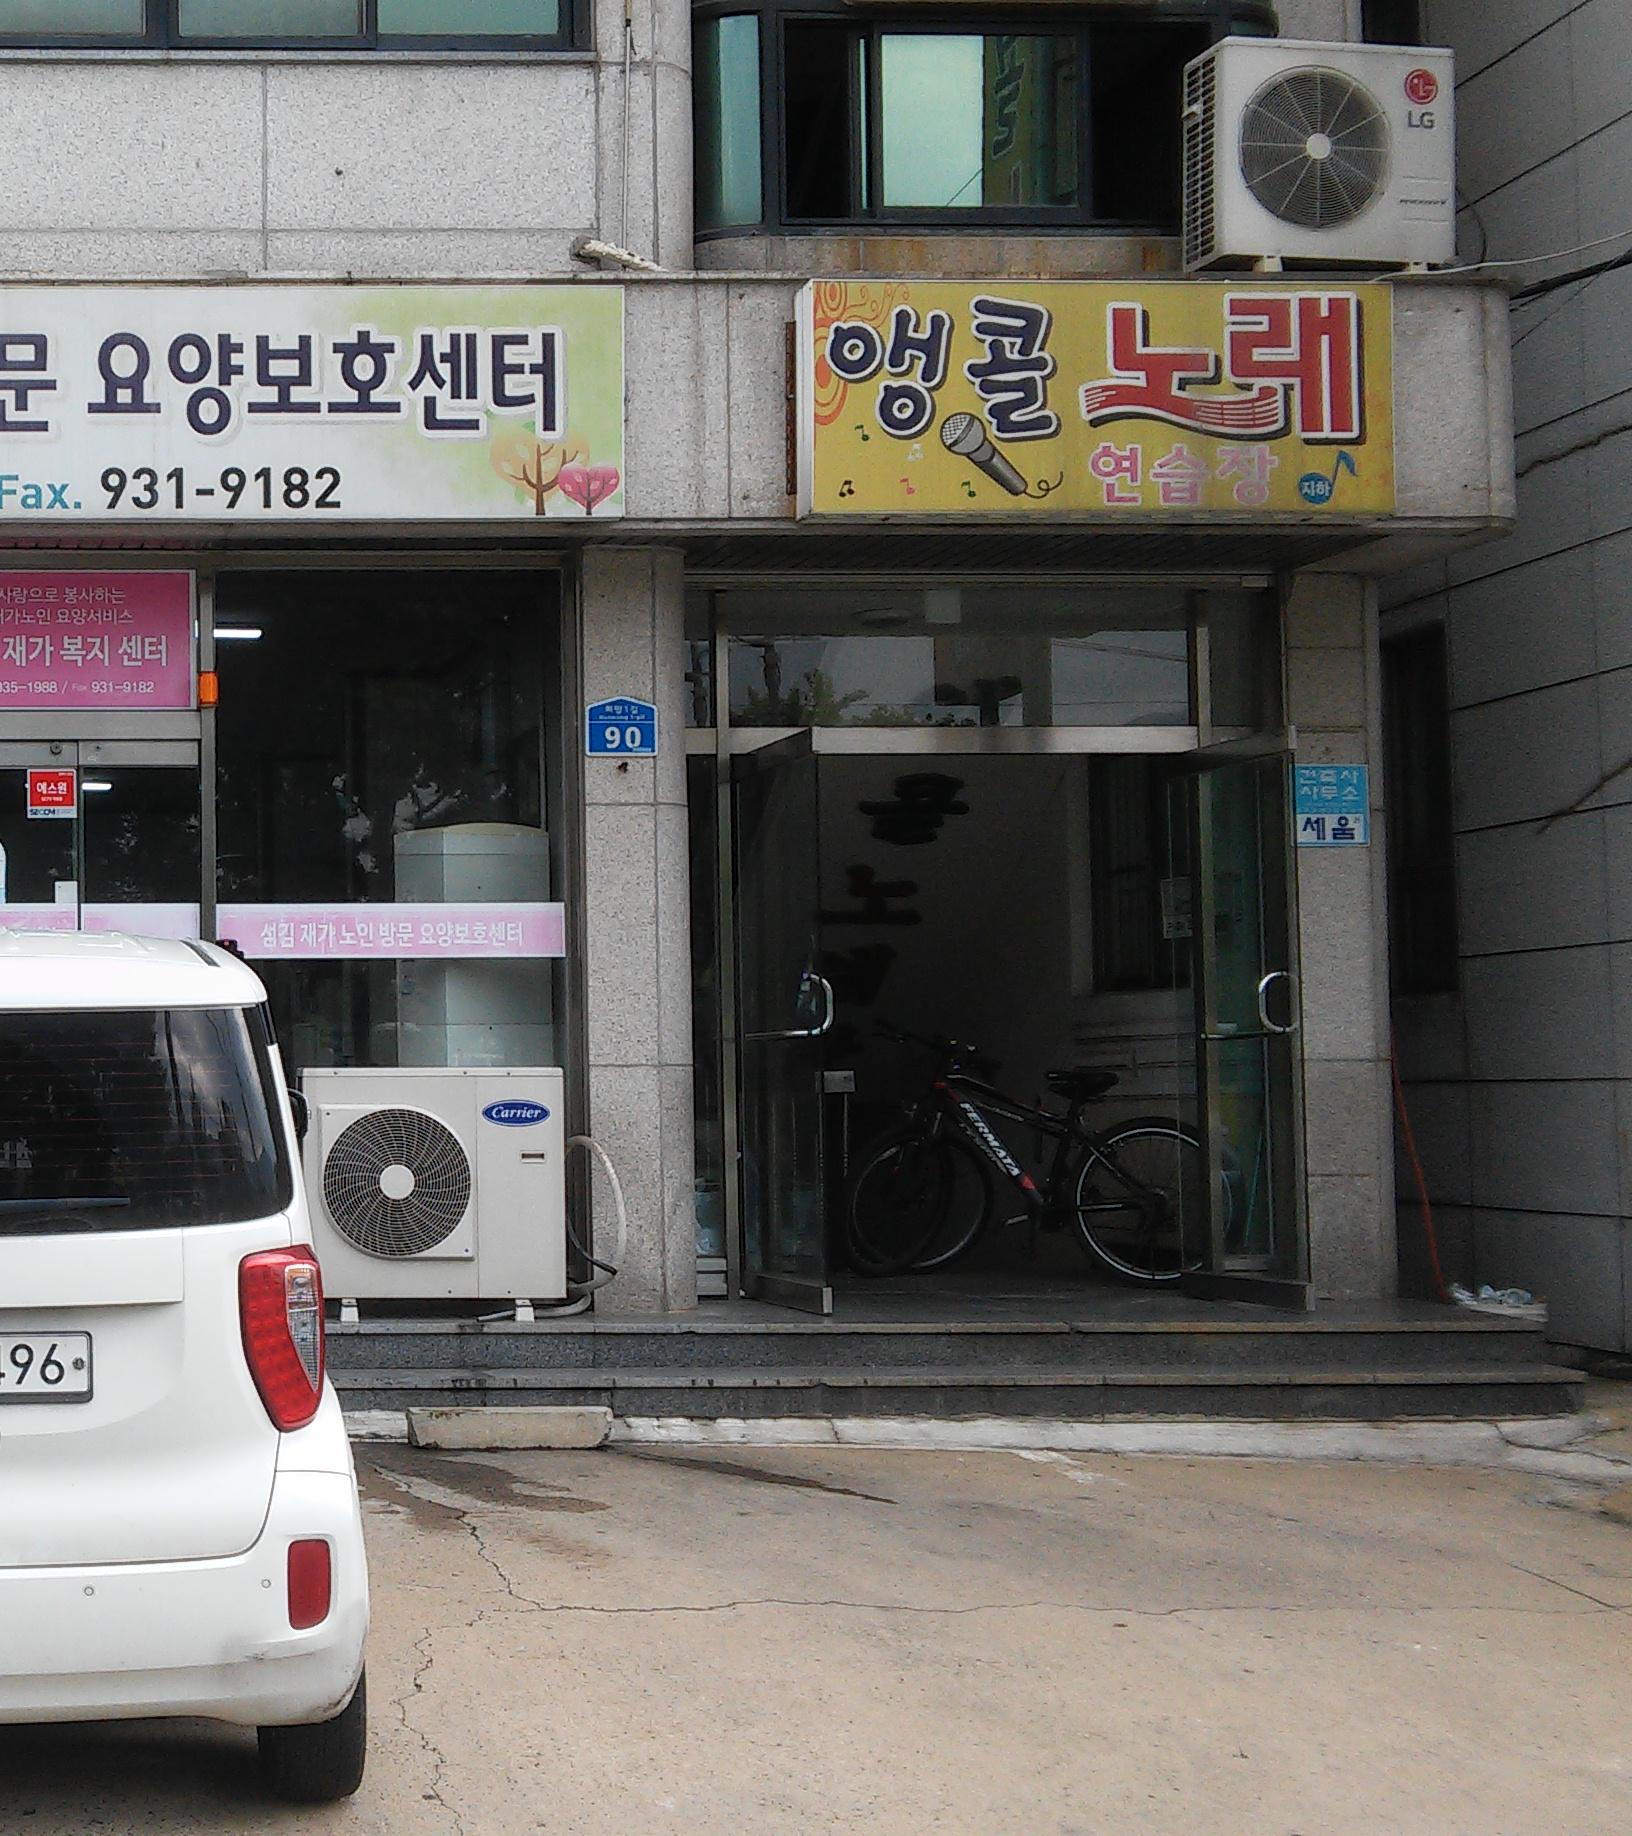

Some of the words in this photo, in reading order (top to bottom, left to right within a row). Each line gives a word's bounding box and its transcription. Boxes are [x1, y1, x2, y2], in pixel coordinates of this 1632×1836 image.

[1407, 110, 1435, 129] LG
[828, 295, 1059, 438] 앵콜
[1079, 292, 1360, 438] 노래
[87, 330, 557, 437] 요양보호센터
[1089, 442, 1279, 506] 연습장
[100, 466, 342, 510] 931-9182
[1302, 480, 1331, 497] 지하
[63, 586, 126, 604] 봉사하는
[55, 607, 134, 625] 요양서비스
[2, 634, 54, 667] 재가
[59, 634, 110, 667] 복지
[118, 634, 168, 667] 센터
[91, 681, 155, 694] 931-9182
[605, 726, 642, 749] 90
[36, 781, 68, 795] 에스원
[1302, 816, 1356, 840] 세움
[260, 922, 294, 948] 섬김
[300, 922, 335, 948] 재가
[339, 922, 374, 948] 노인
[378, 922, 415, 948] 방문
[418, 922, 524, 948] 요양보호센터
[491, 1105, 542, 1119] Carrier
